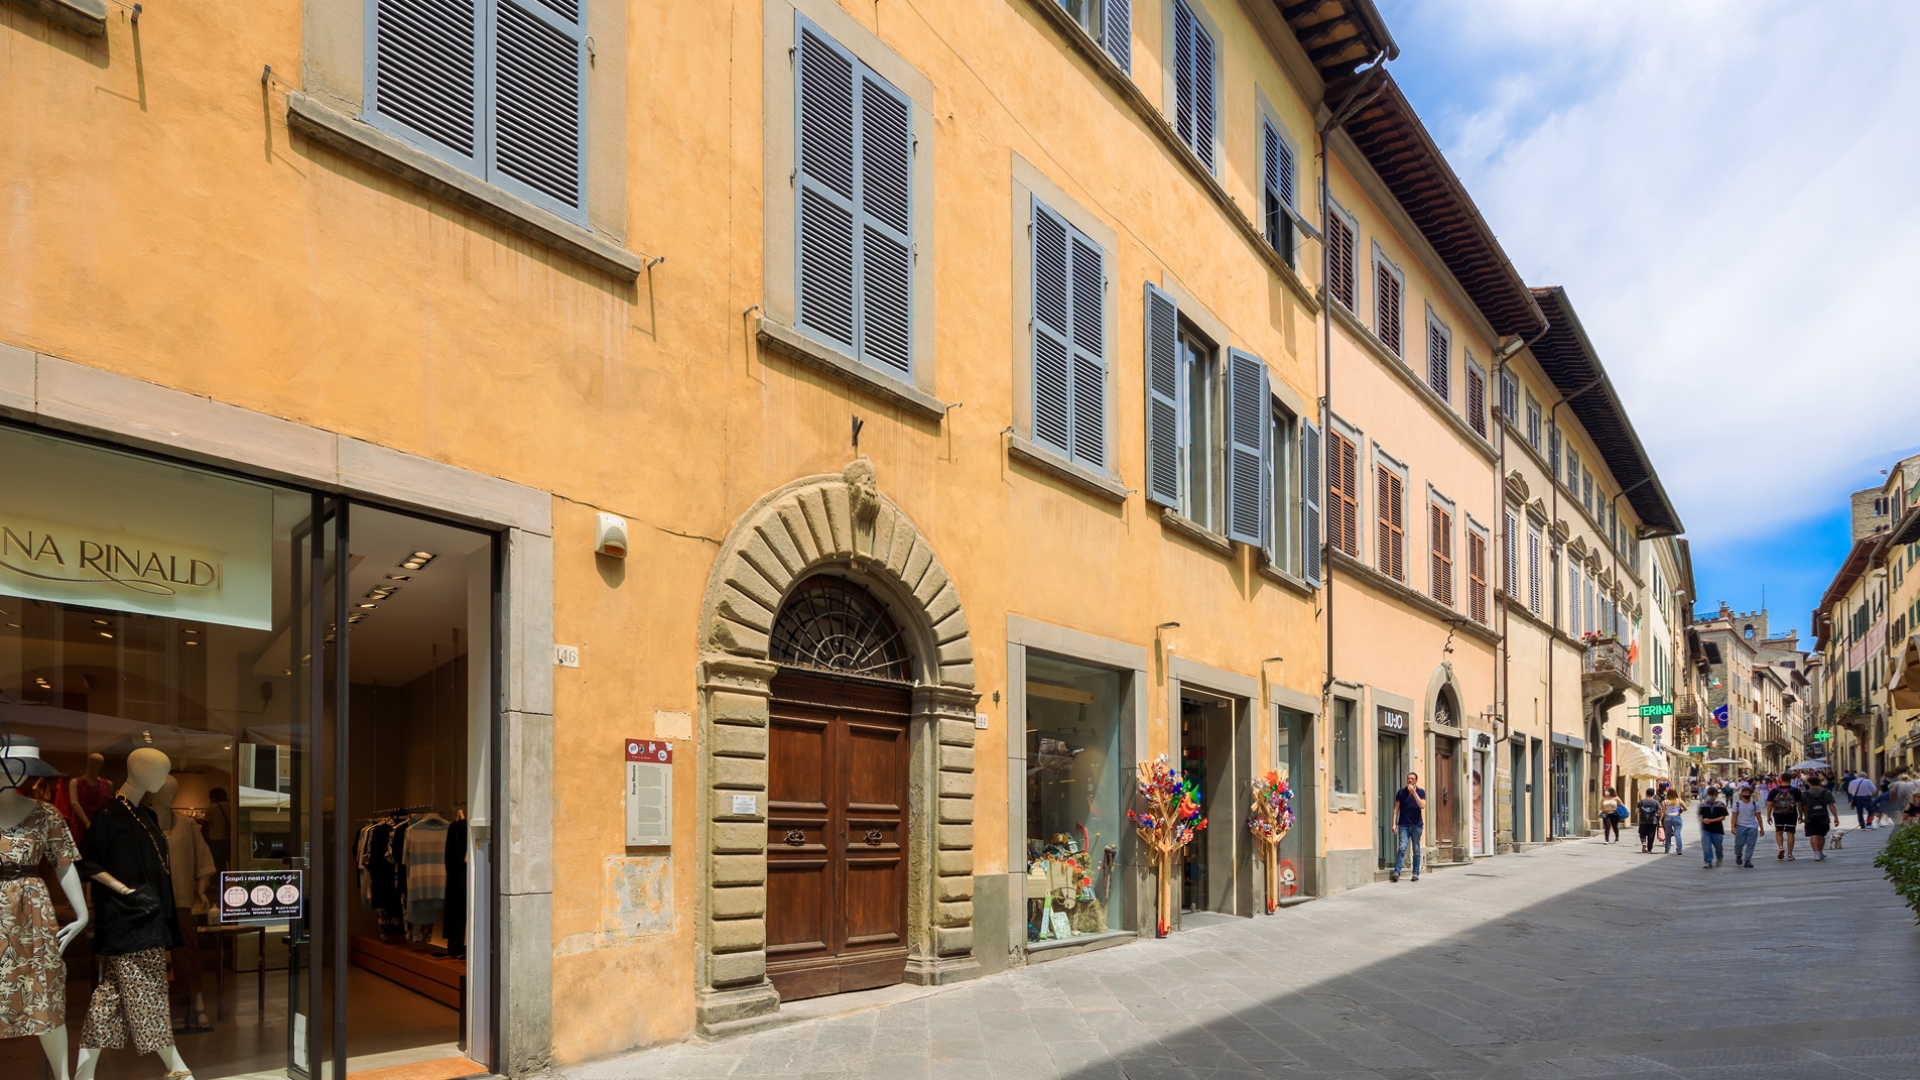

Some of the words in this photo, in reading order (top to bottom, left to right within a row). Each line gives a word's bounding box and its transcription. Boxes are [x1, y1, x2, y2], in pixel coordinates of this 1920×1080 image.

[2, 527, 65, 565] NA
[79, 540, 224, 594] RINALDI
[556, 648, 578, 664] 146
[267, 874, 298, 884] servizi
